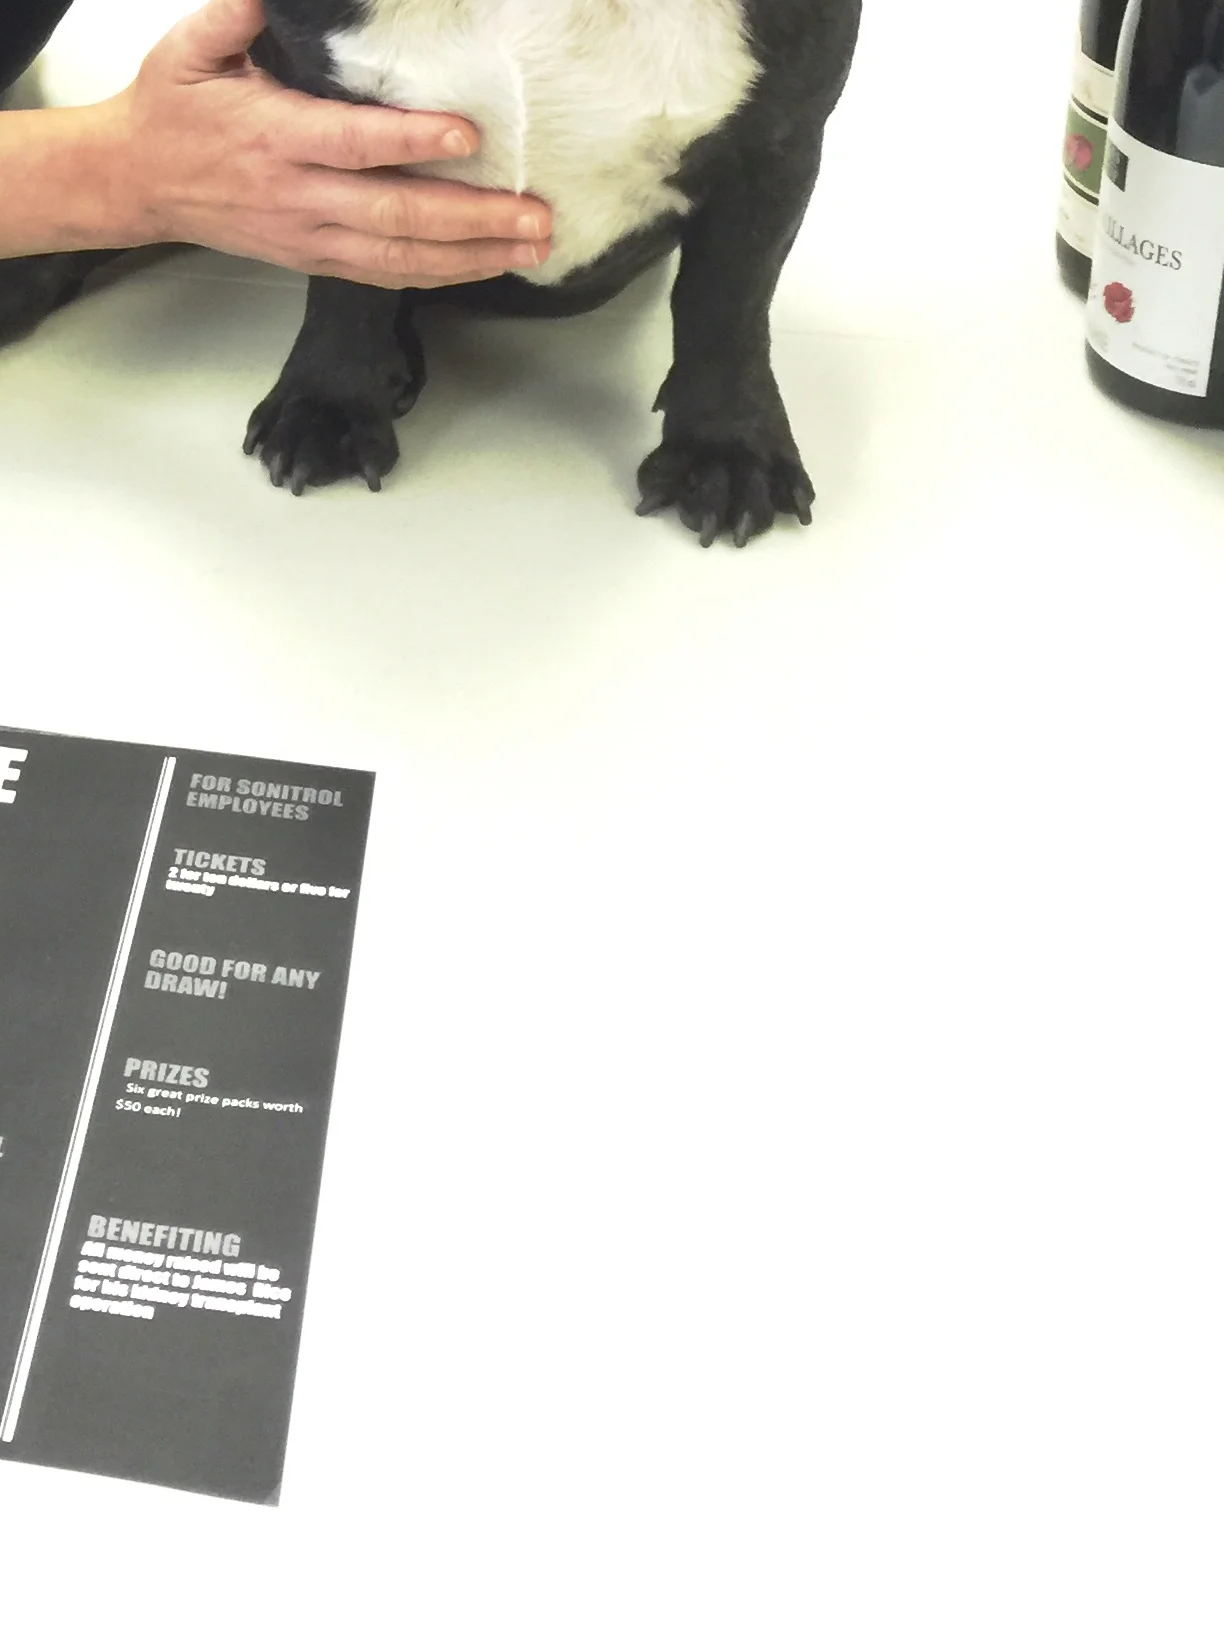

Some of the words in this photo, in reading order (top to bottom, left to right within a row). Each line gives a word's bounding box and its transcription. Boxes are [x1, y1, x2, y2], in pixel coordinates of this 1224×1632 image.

[1105, 215, 1184, 271] ILLAGES
[189, 773, 232, 793] FOR
[235, 779, 344, 807] SONITROL
[186, 792, 309, 821] EMPLOYEES
[168, 866, 179, 879] 2
[174, 848, 266, 876] TICKETS
[149, 949, 217, 975] GOOD
[221, 959, 268, 983] FOR
[271, 966, 322, 989] ANY
[144, 970, 228, 1000] DRAW!
[123, 1057, 210, 1088] PRIZES
[115, 1098, 142, 1112] $50
[143, 1104, 182, 1118] each!
[126, 1082, 145, 1094] Six
[147, 1087, 183, 1100] great
[185, 1092, 219, 1105] prize
[221, 1097, 260, 1110] packs
[262, 1101, 304, 1114] worth
[87, 1214, 241, 1257] BENEFITING
